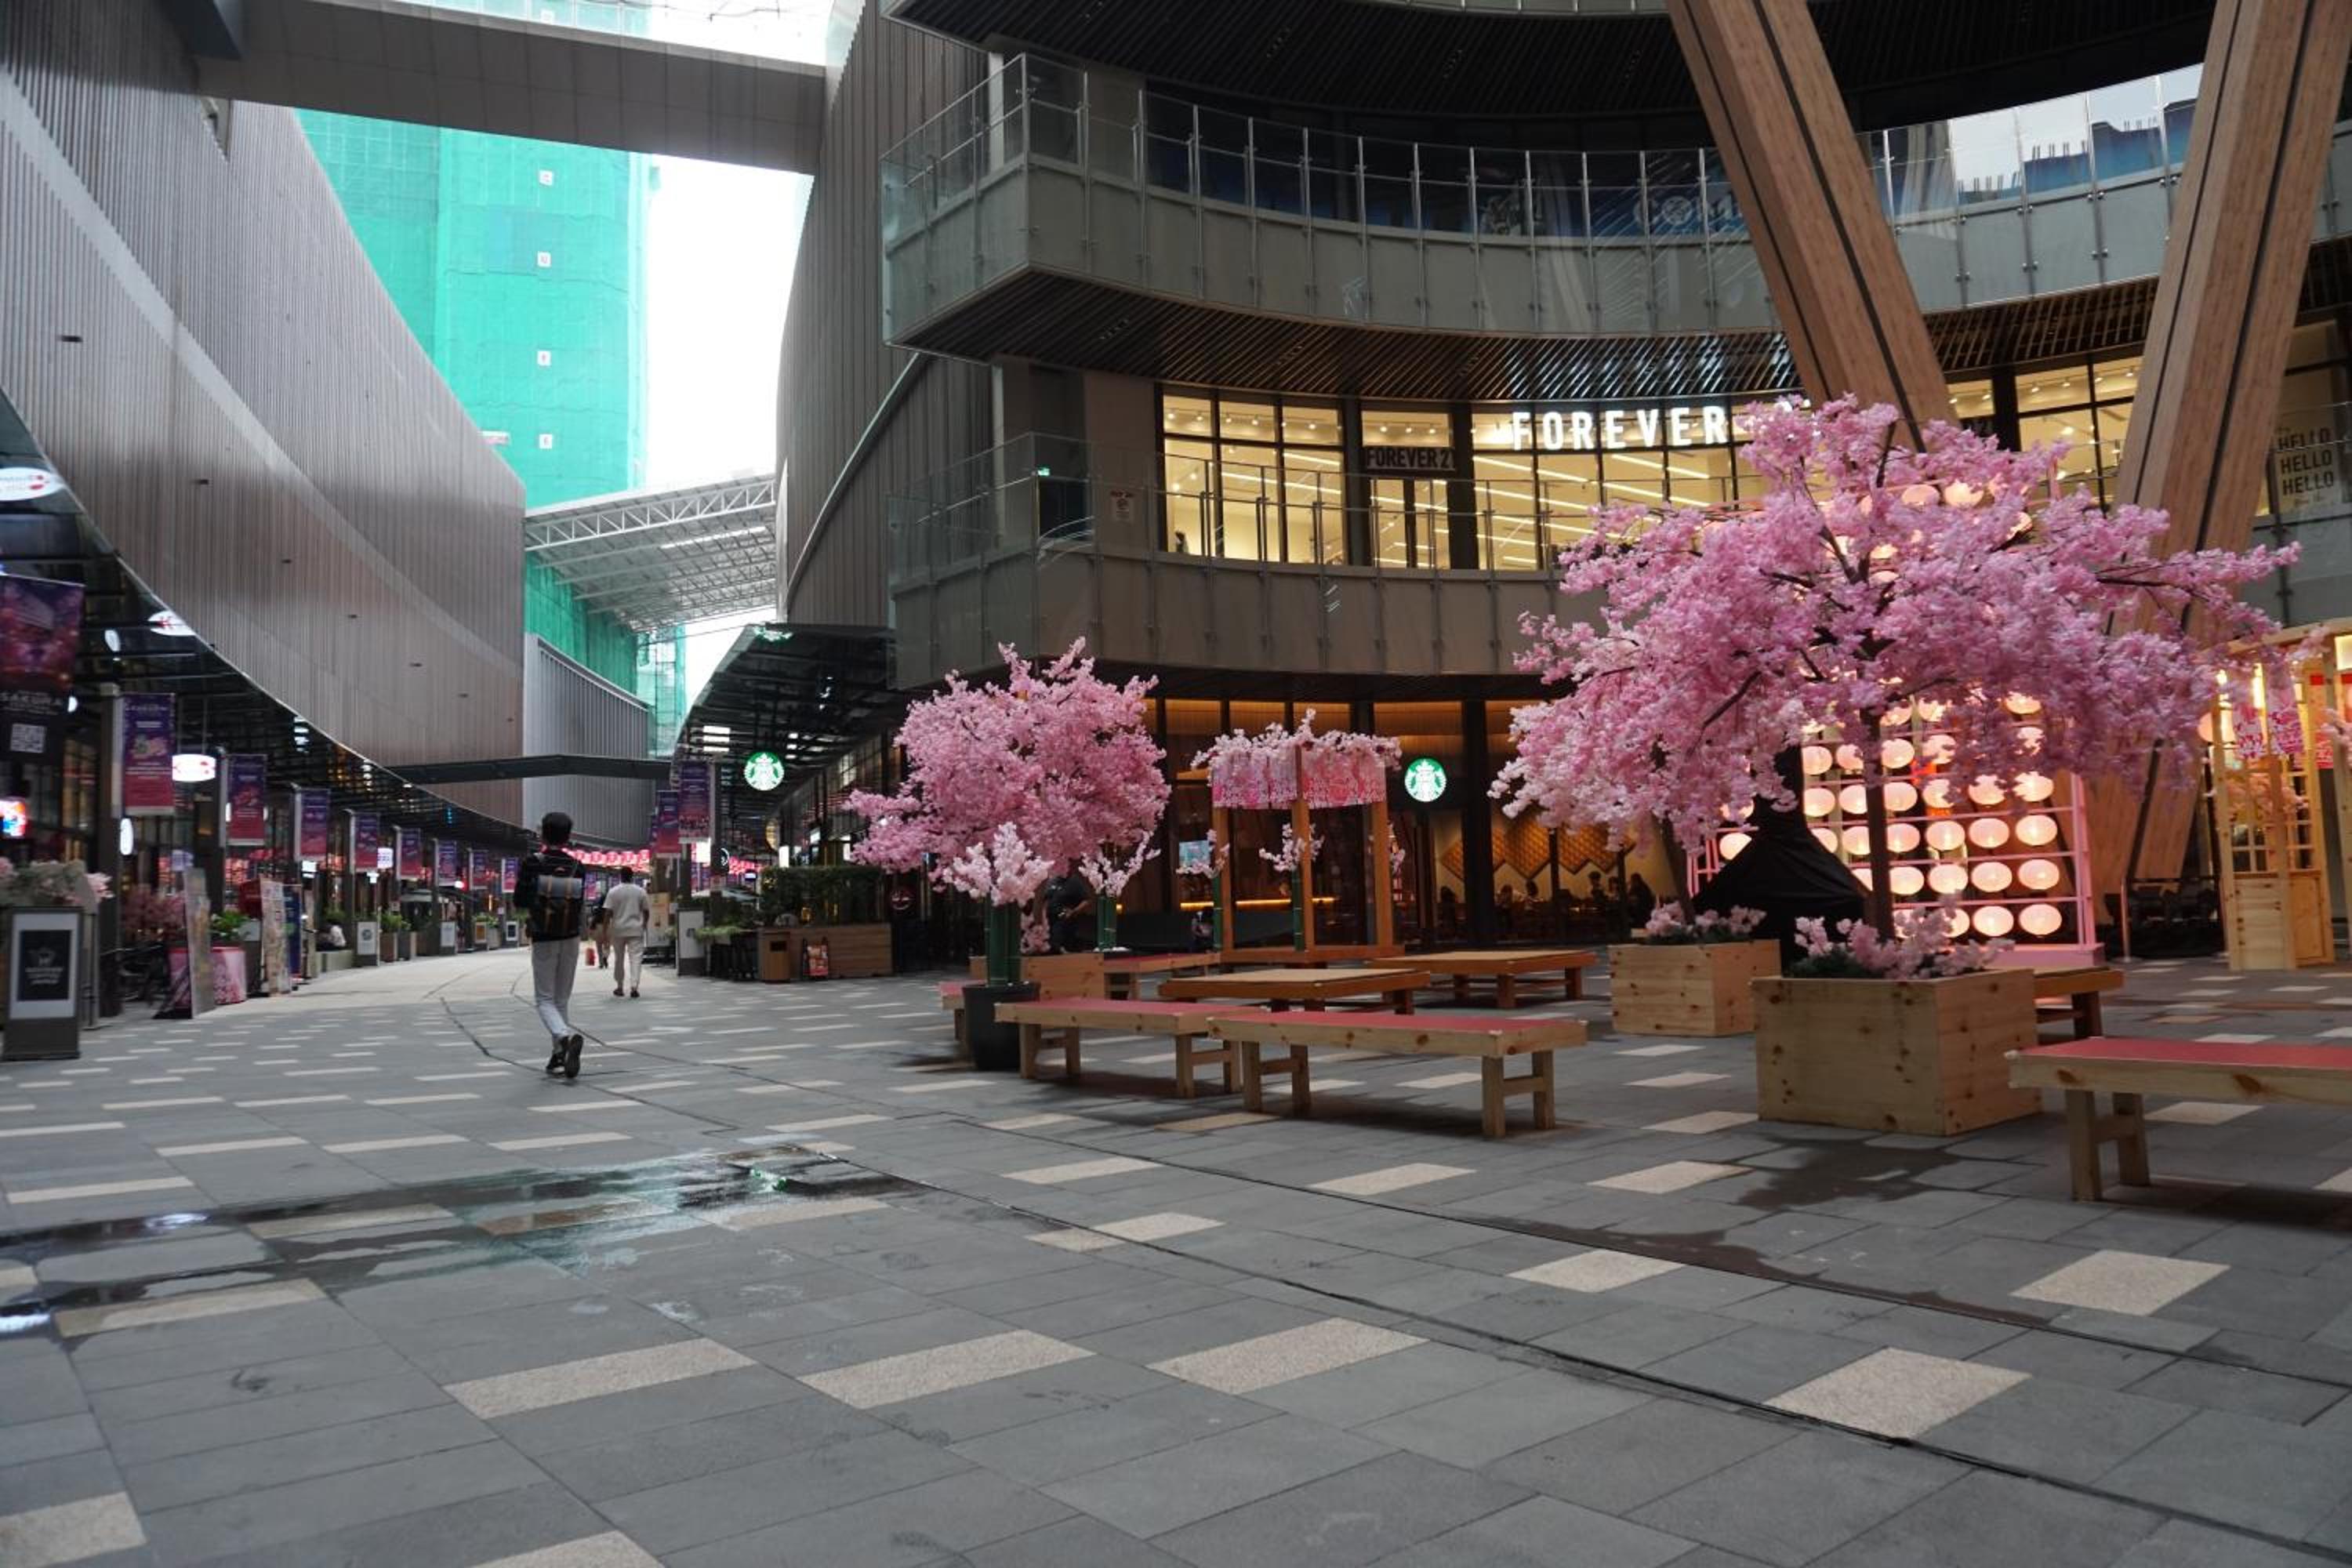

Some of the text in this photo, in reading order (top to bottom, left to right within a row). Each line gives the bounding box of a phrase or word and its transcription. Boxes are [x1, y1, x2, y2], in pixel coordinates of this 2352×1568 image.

[1512, 405, 1728, 451] FOREVER
[1367, 448, 1437, 468] FOREVER
[2281, 449, 2333, 474] HELLO
[2283, 470, 2335, 495] HELLO
